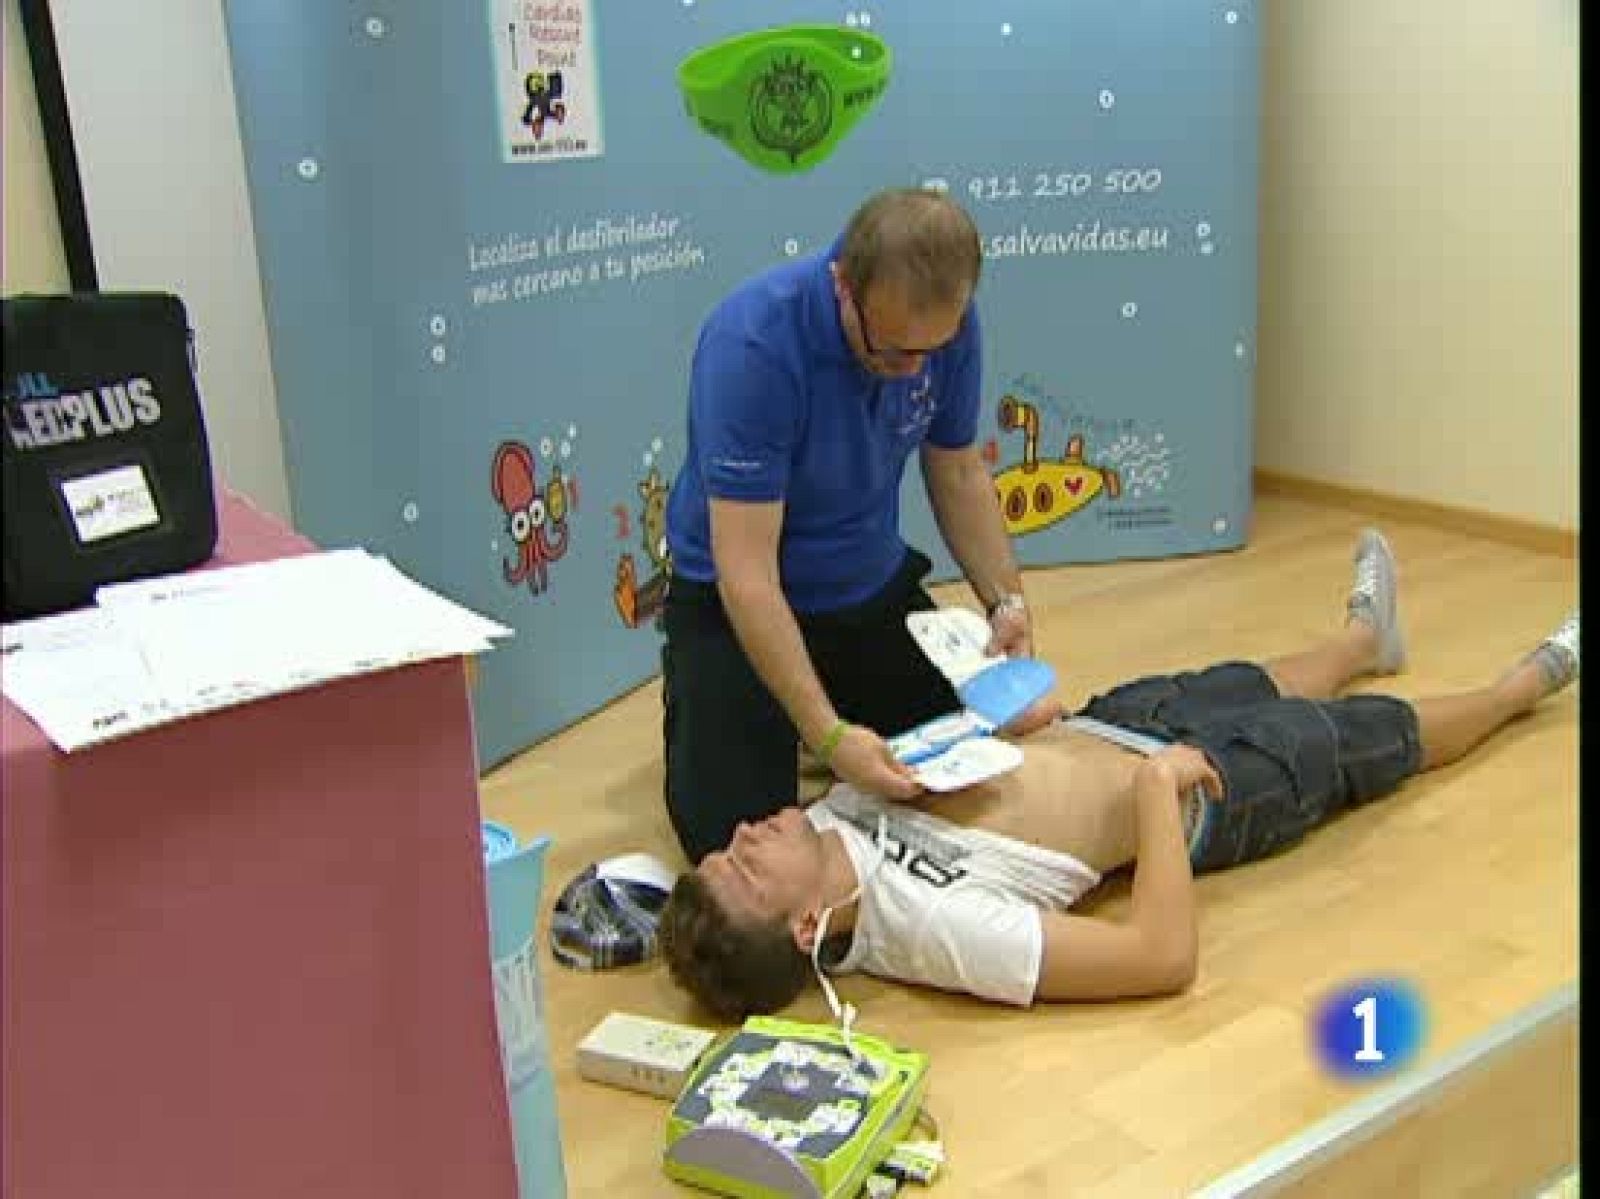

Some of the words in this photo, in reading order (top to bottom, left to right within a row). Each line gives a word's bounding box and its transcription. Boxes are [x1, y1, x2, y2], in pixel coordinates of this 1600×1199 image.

[967, 174, 1022, 201] 911
[1033, 173, 1092, 197] 250
[1102, 168, 1163, 193] 500
[470, 232, 539, 271] Localiza
[546, 224, 560, 257] el
[980, 218, 1168, 256] .salvavidas.eu
[512, 265, 582, 299] cercano
[590, 261, 601, 281] a
[605, 254, 625, 280] tu
